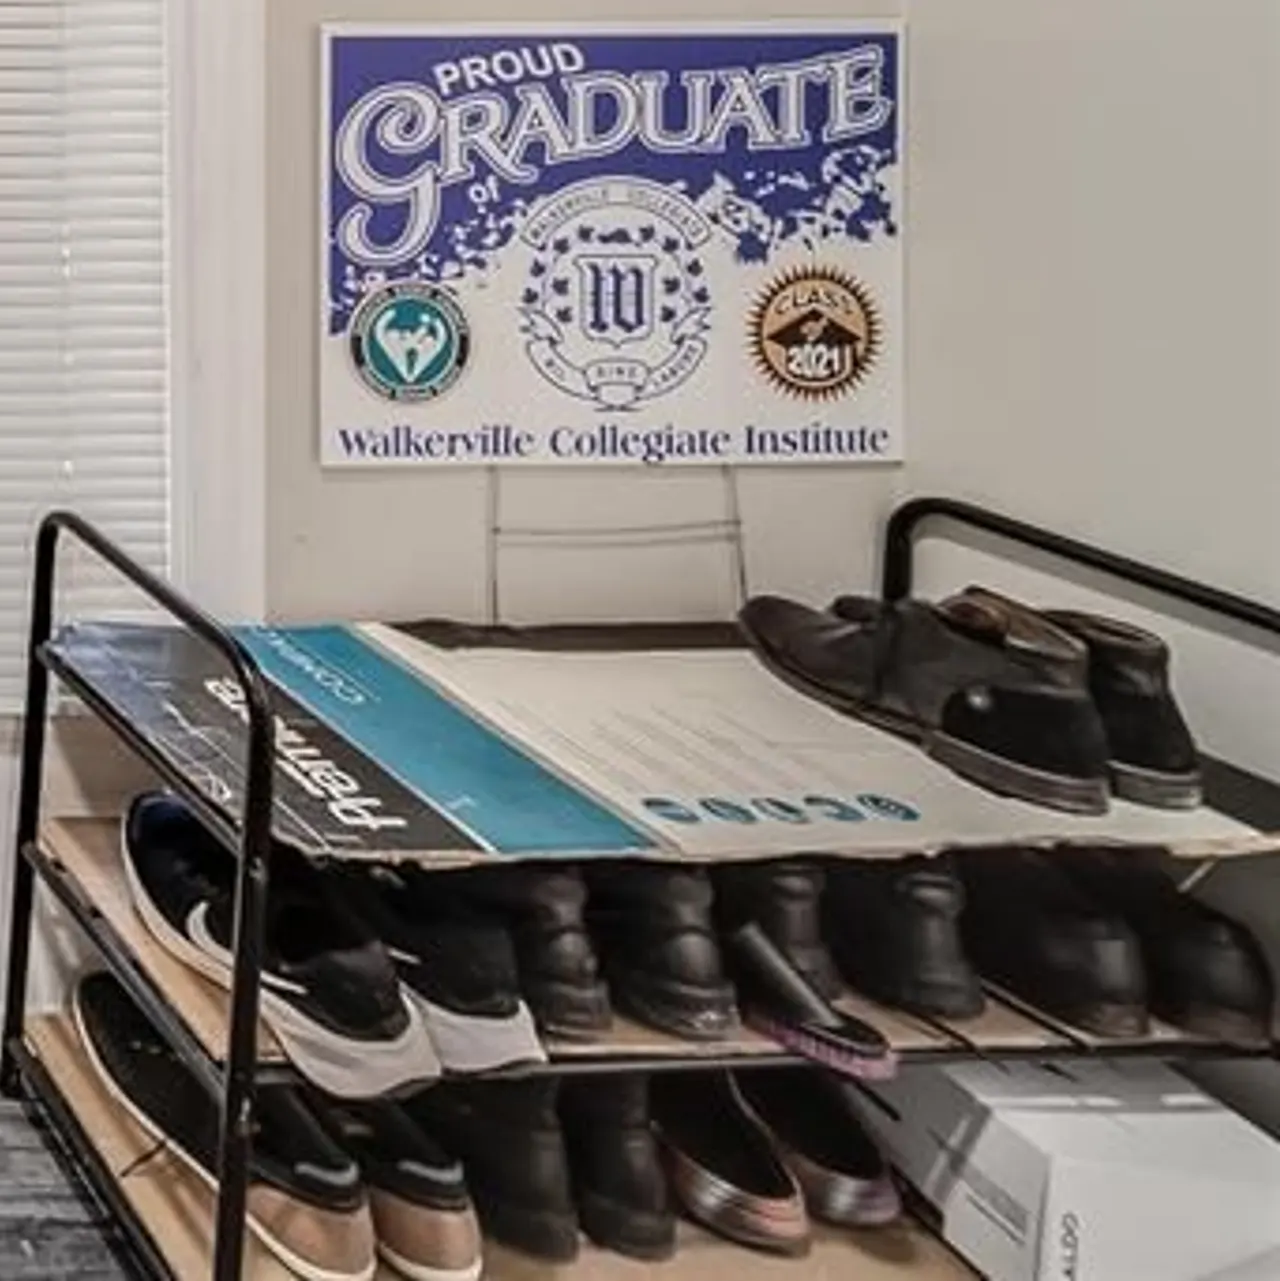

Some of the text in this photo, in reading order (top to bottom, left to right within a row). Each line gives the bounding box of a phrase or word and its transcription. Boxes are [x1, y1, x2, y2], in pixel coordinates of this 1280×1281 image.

[432, 42, 585, 97] PROUD
[334, 42, 894, 267] GRADUATE
[468, 176, 501, 207] of
[788, 343, 840, 378] 2021
[338, 421, 890, 464] Walkerville Collegiate Institute
